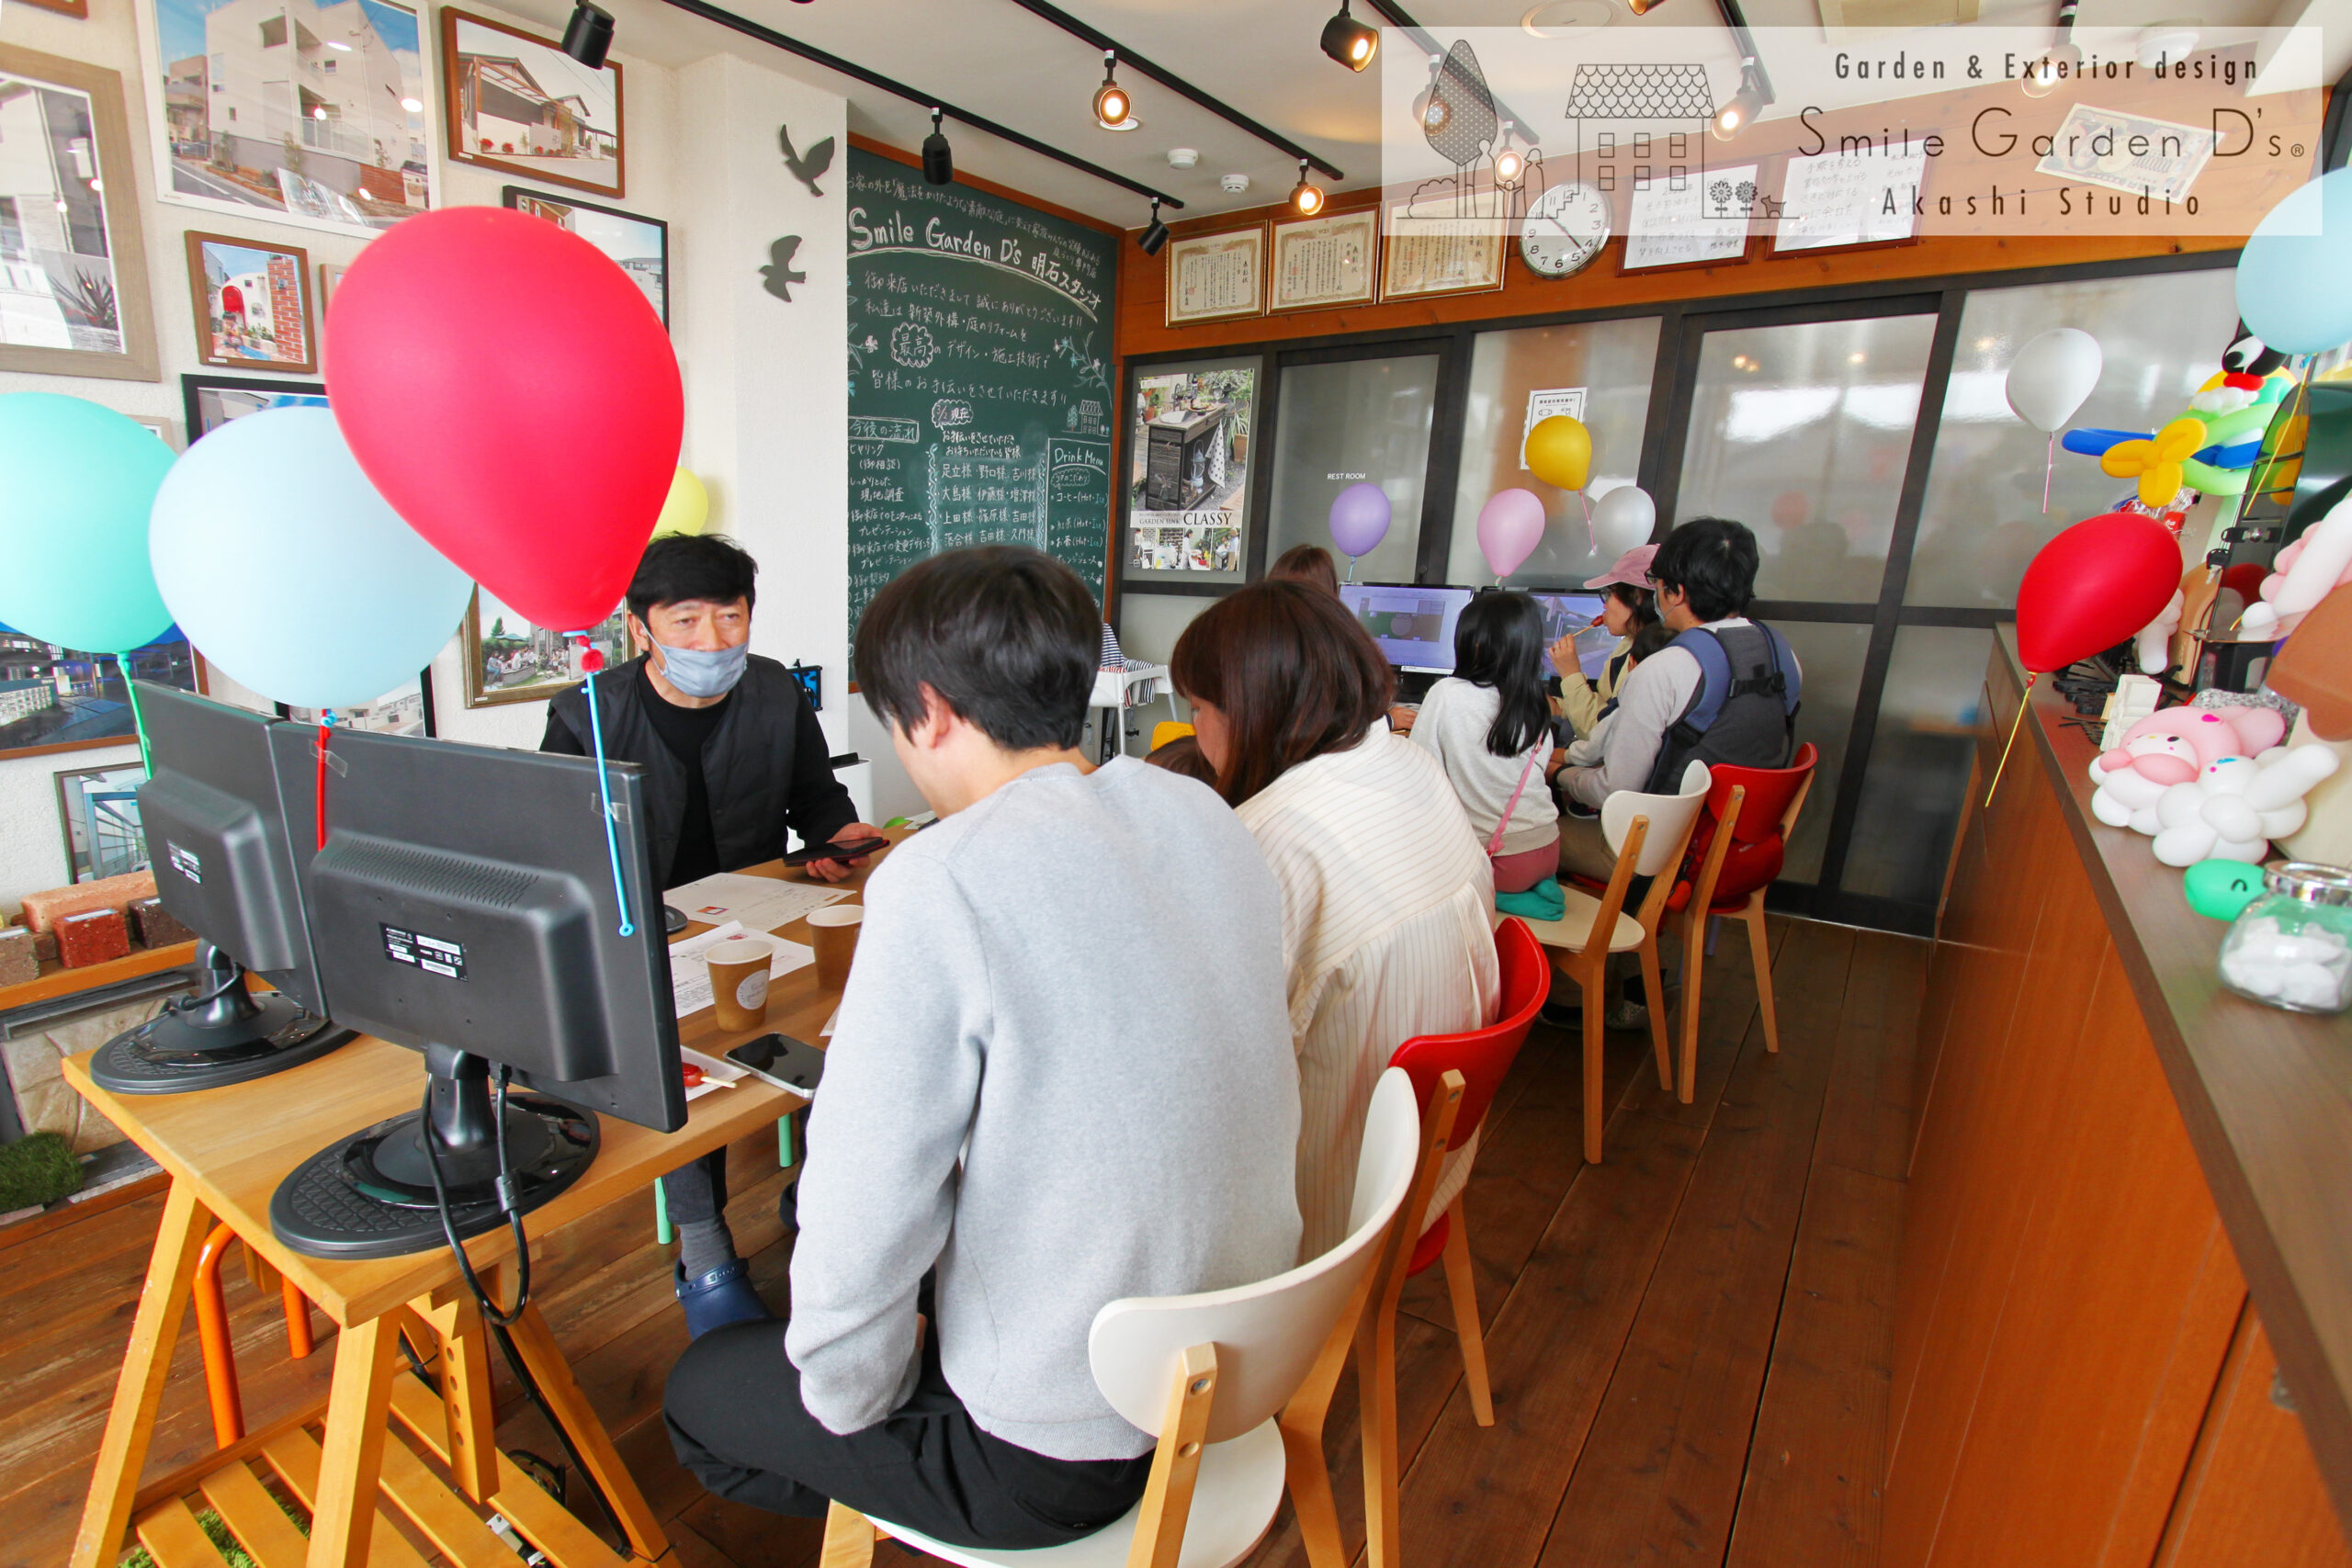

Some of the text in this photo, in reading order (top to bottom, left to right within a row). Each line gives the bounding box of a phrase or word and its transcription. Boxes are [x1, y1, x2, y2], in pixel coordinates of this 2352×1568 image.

[1563, 189, 1574, 200] 12
[1550, 197, 1556, 206] 11
[1589, 204, 1599, 213] 2
[1591, 220, 1601, 230] 3
[1528, 229, 1536, 238] 9
[1585, 239, 1592, 247] 4
[1530, 245, 1539, 254] 8
[848, 207, 1102, 310] Smile Garden D's 明石スタジオ
[1541, 256, 1548, 265] 7
[1571, 253, 1580, 262] 5
[1555, 259, 1564, 268] 6
[900, 331, 928, 358] 最高
[850, 419, 915, 440] 今後の流れ
[1054, 447, 1082, 463] Drink
[1183, 513, 1232, 525] CLASSY
